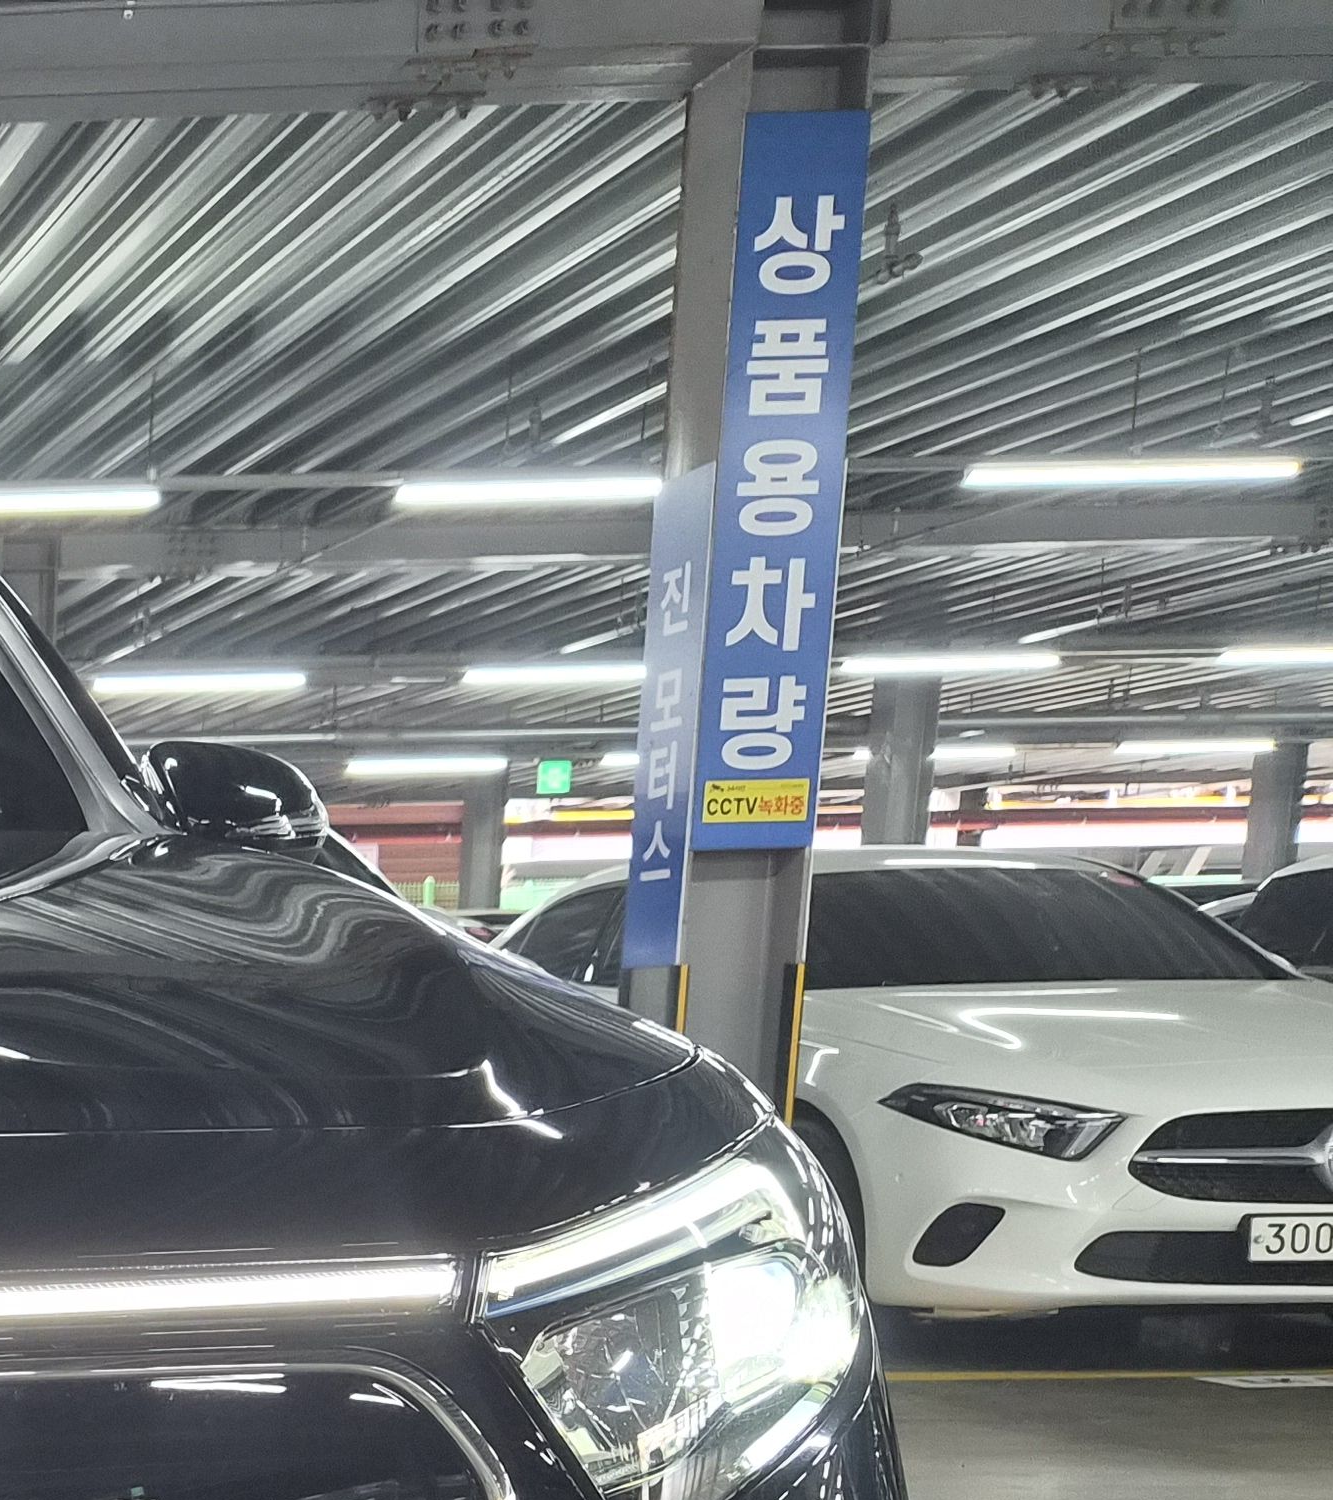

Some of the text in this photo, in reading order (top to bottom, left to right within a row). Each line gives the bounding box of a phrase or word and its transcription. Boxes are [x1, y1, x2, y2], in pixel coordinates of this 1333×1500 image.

[719, 195, 845, 770] 상품용차량
[639, 560, 692, 882] 진 모터스
